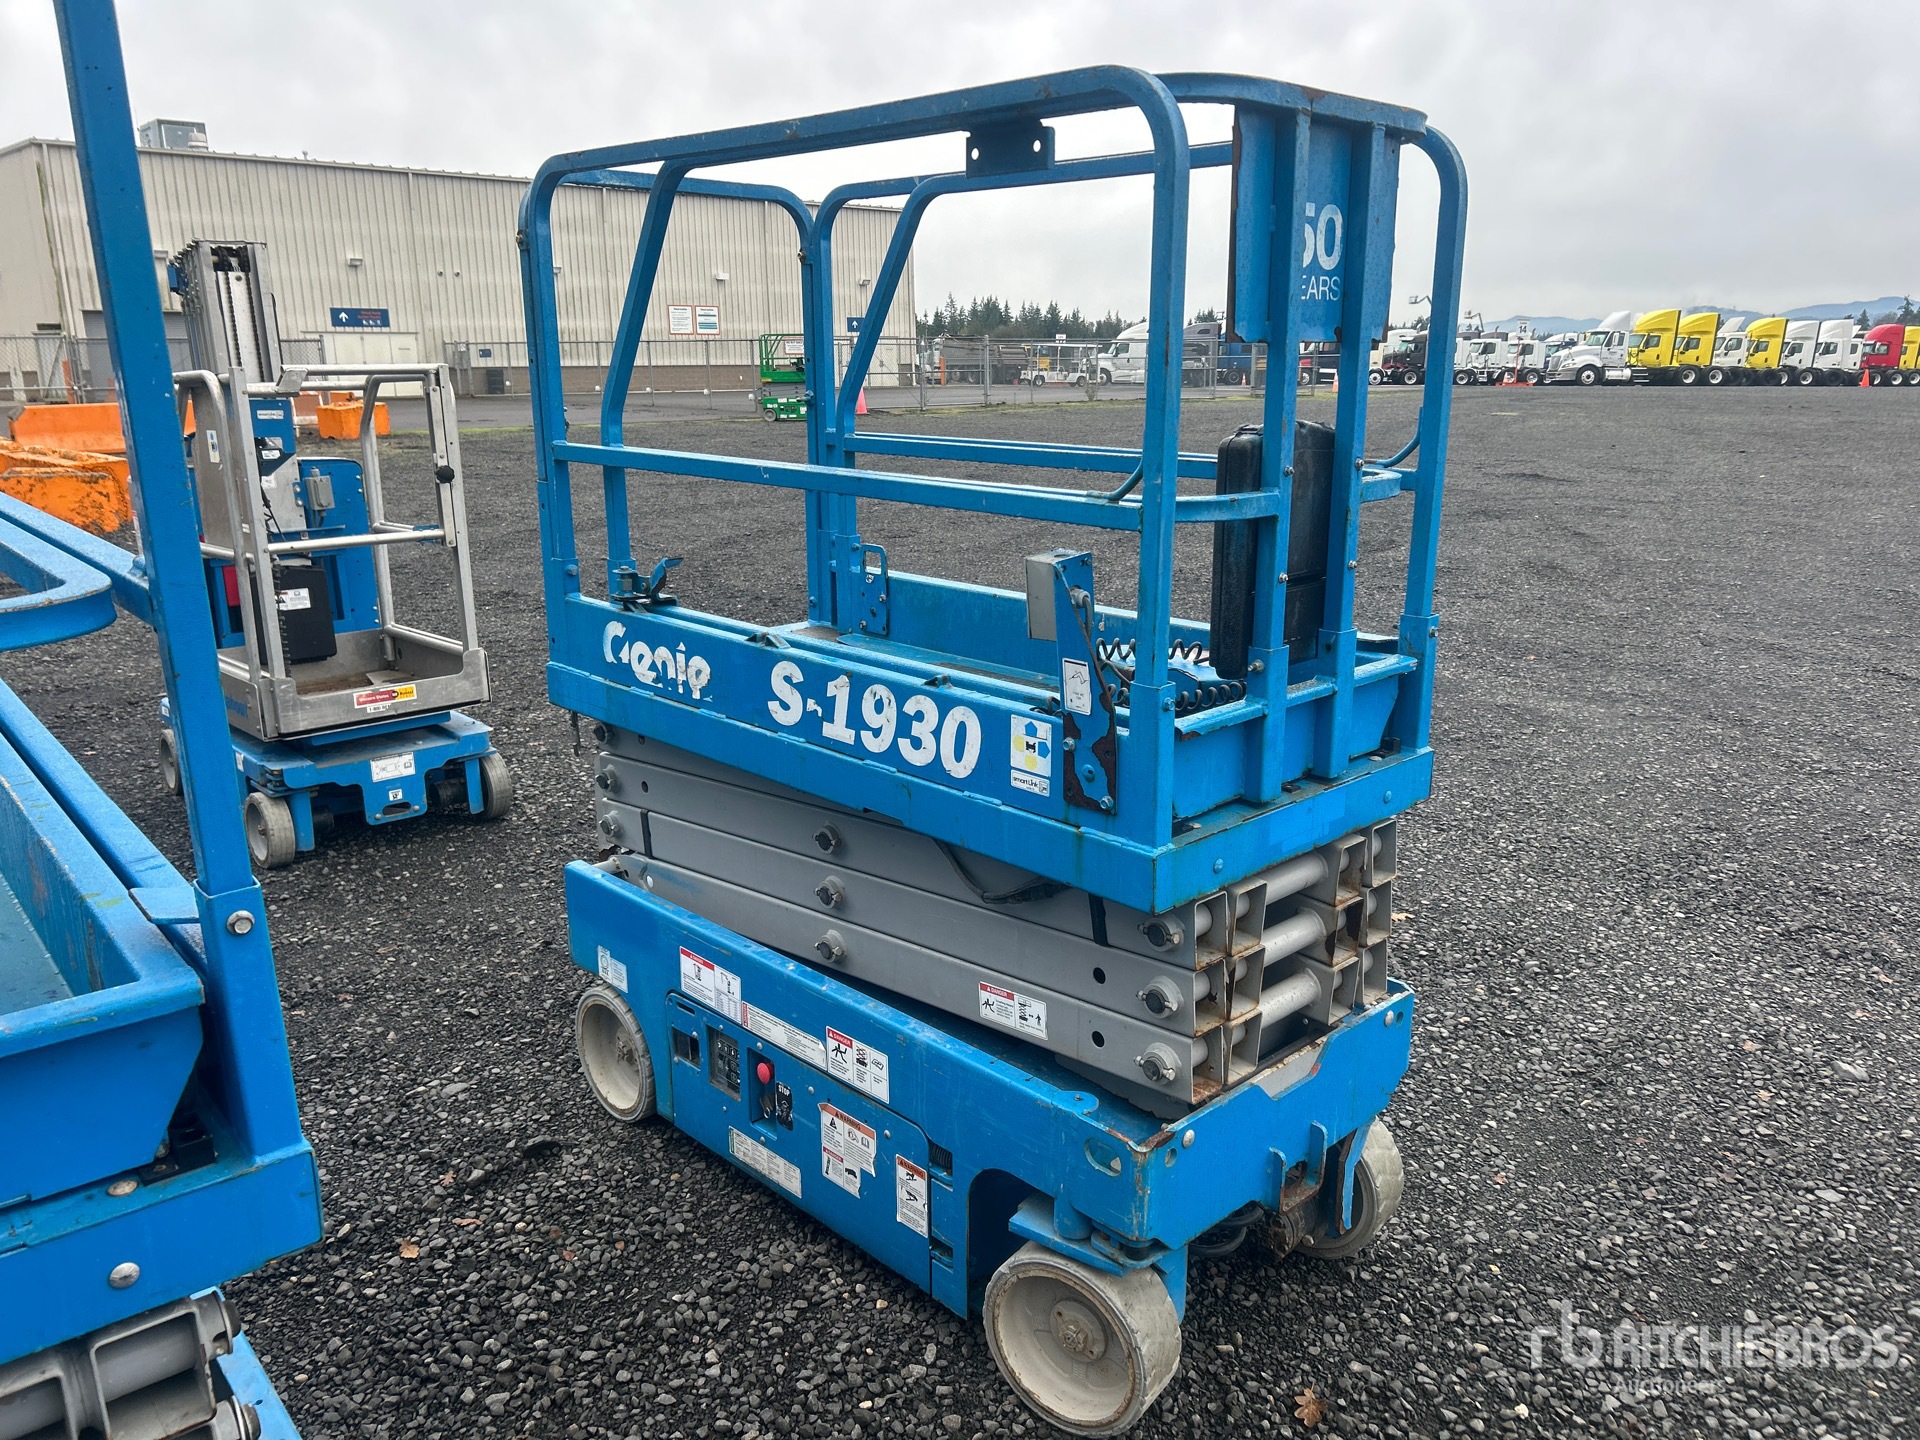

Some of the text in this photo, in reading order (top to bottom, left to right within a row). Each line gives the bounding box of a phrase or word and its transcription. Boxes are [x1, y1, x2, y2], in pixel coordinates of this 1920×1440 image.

[1518, 325, 1528, 334] 14
[603, 620, 711, 700] Genie
[767, 660, 982, 780] S-1930
[991, 987, 1008, 998] DANGER
[833, 1032, 852, 1047] DANGER
[777, 1084, 791, 1097] STOP
[838, 1112, 861, 1131] WARNING
[902, 1158, 925, 1178] WARNING
